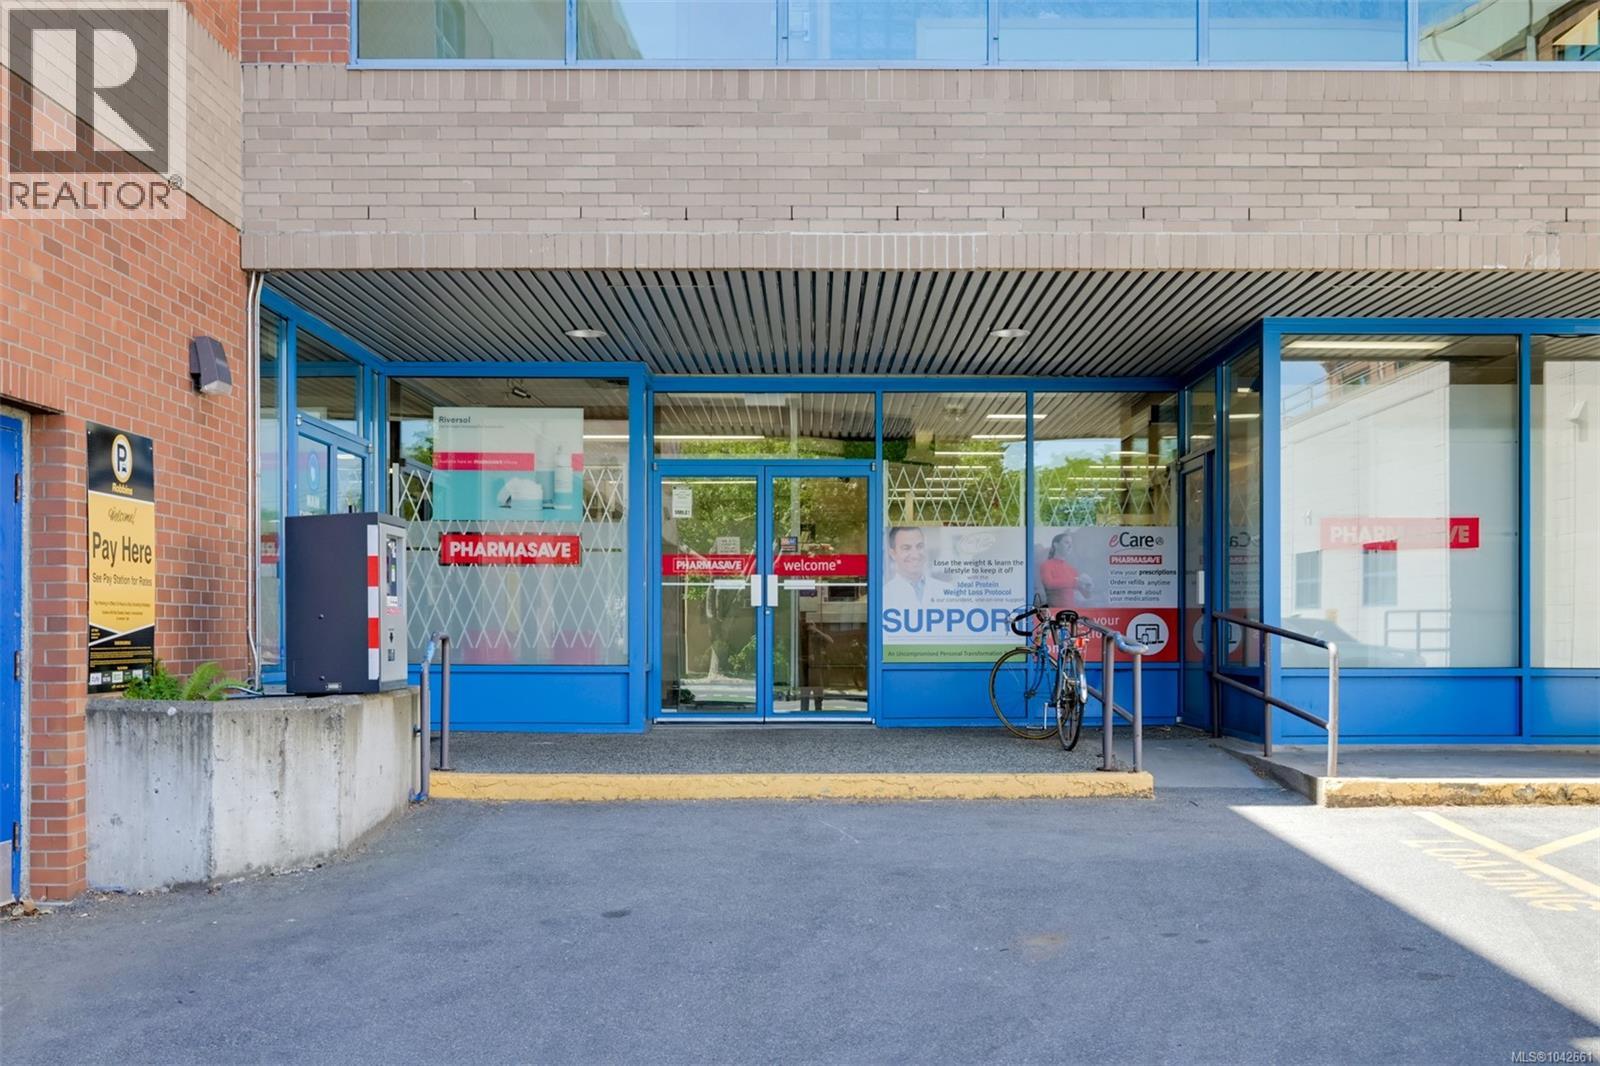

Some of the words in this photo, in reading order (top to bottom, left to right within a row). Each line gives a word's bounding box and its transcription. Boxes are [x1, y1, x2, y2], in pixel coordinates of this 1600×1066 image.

[438, 416, 471, 424] Riversol
[1108, 531, 1155, 548] eCare
[1330, 525, 1470, 544] PHARMVE
[92, 531, 118, 568] Pay
[122, 535, 152, 565] Here
[450, 541, 571, 558] PHARMASAVE
[676, 560, 742, 570] PHARMASAVE
[963, 560, 986, 568] weight
[1111, 556, 1161, 564] PHARMASAVE
[980, 567, 997, 575] keep
[103, 573, 112, 586] Pay
[113, 573, 130, 585] Station
